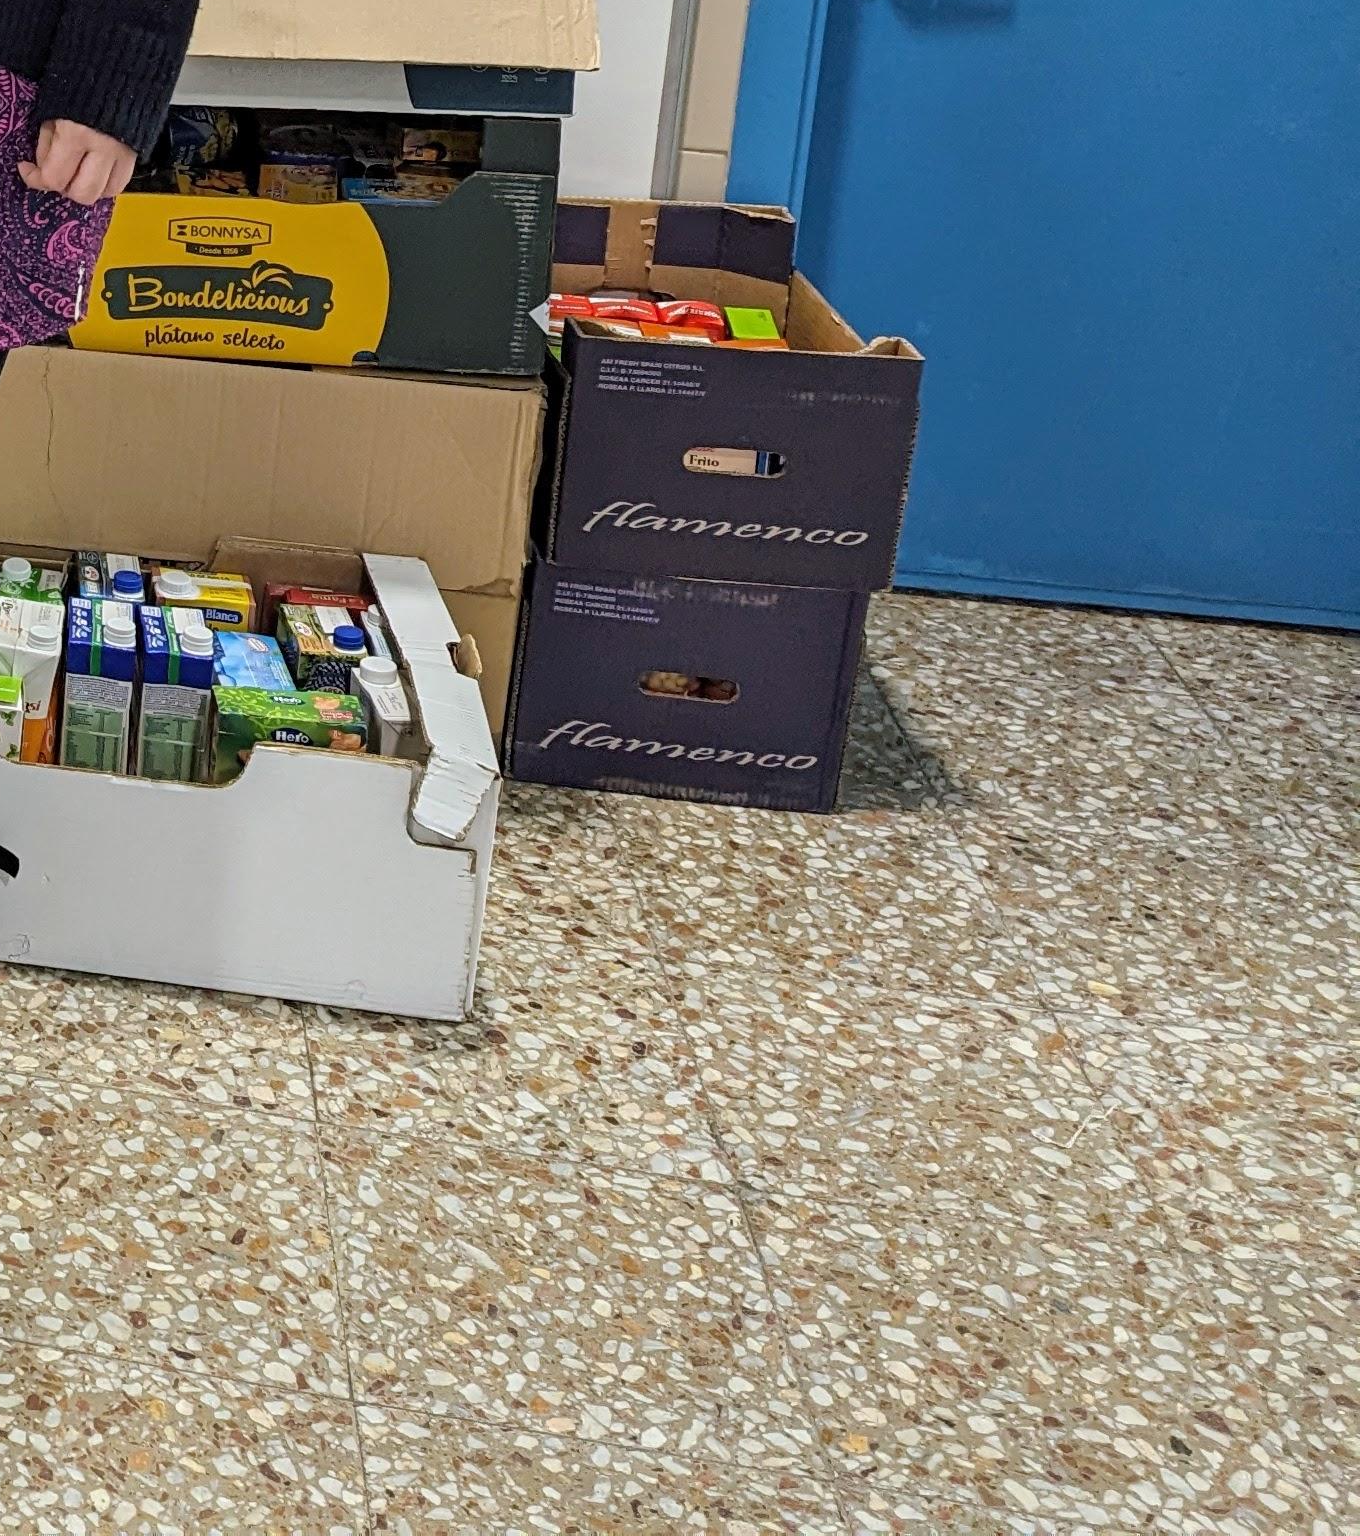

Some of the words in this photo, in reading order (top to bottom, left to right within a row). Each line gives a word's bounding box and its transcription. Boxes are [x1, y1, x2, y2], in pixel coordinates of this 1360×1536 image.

[190, 225, 262, 239] BONNYSA
[199, 246, 221, 254] Desde
[128, 273, 310, 316] Bondelicious
[145, 323, 214, 347] plátano
[223, 328, 285, 350] selecto
[689, 454, 719, 467] Frito
[583, 501, 869, 548] flamenco
[206, 608, 239, 623] Blanca
[274, 696, 302, 705] Hero
[275, 730, 309, 744] Hero
[540, 721, 818, 770] flamenco
